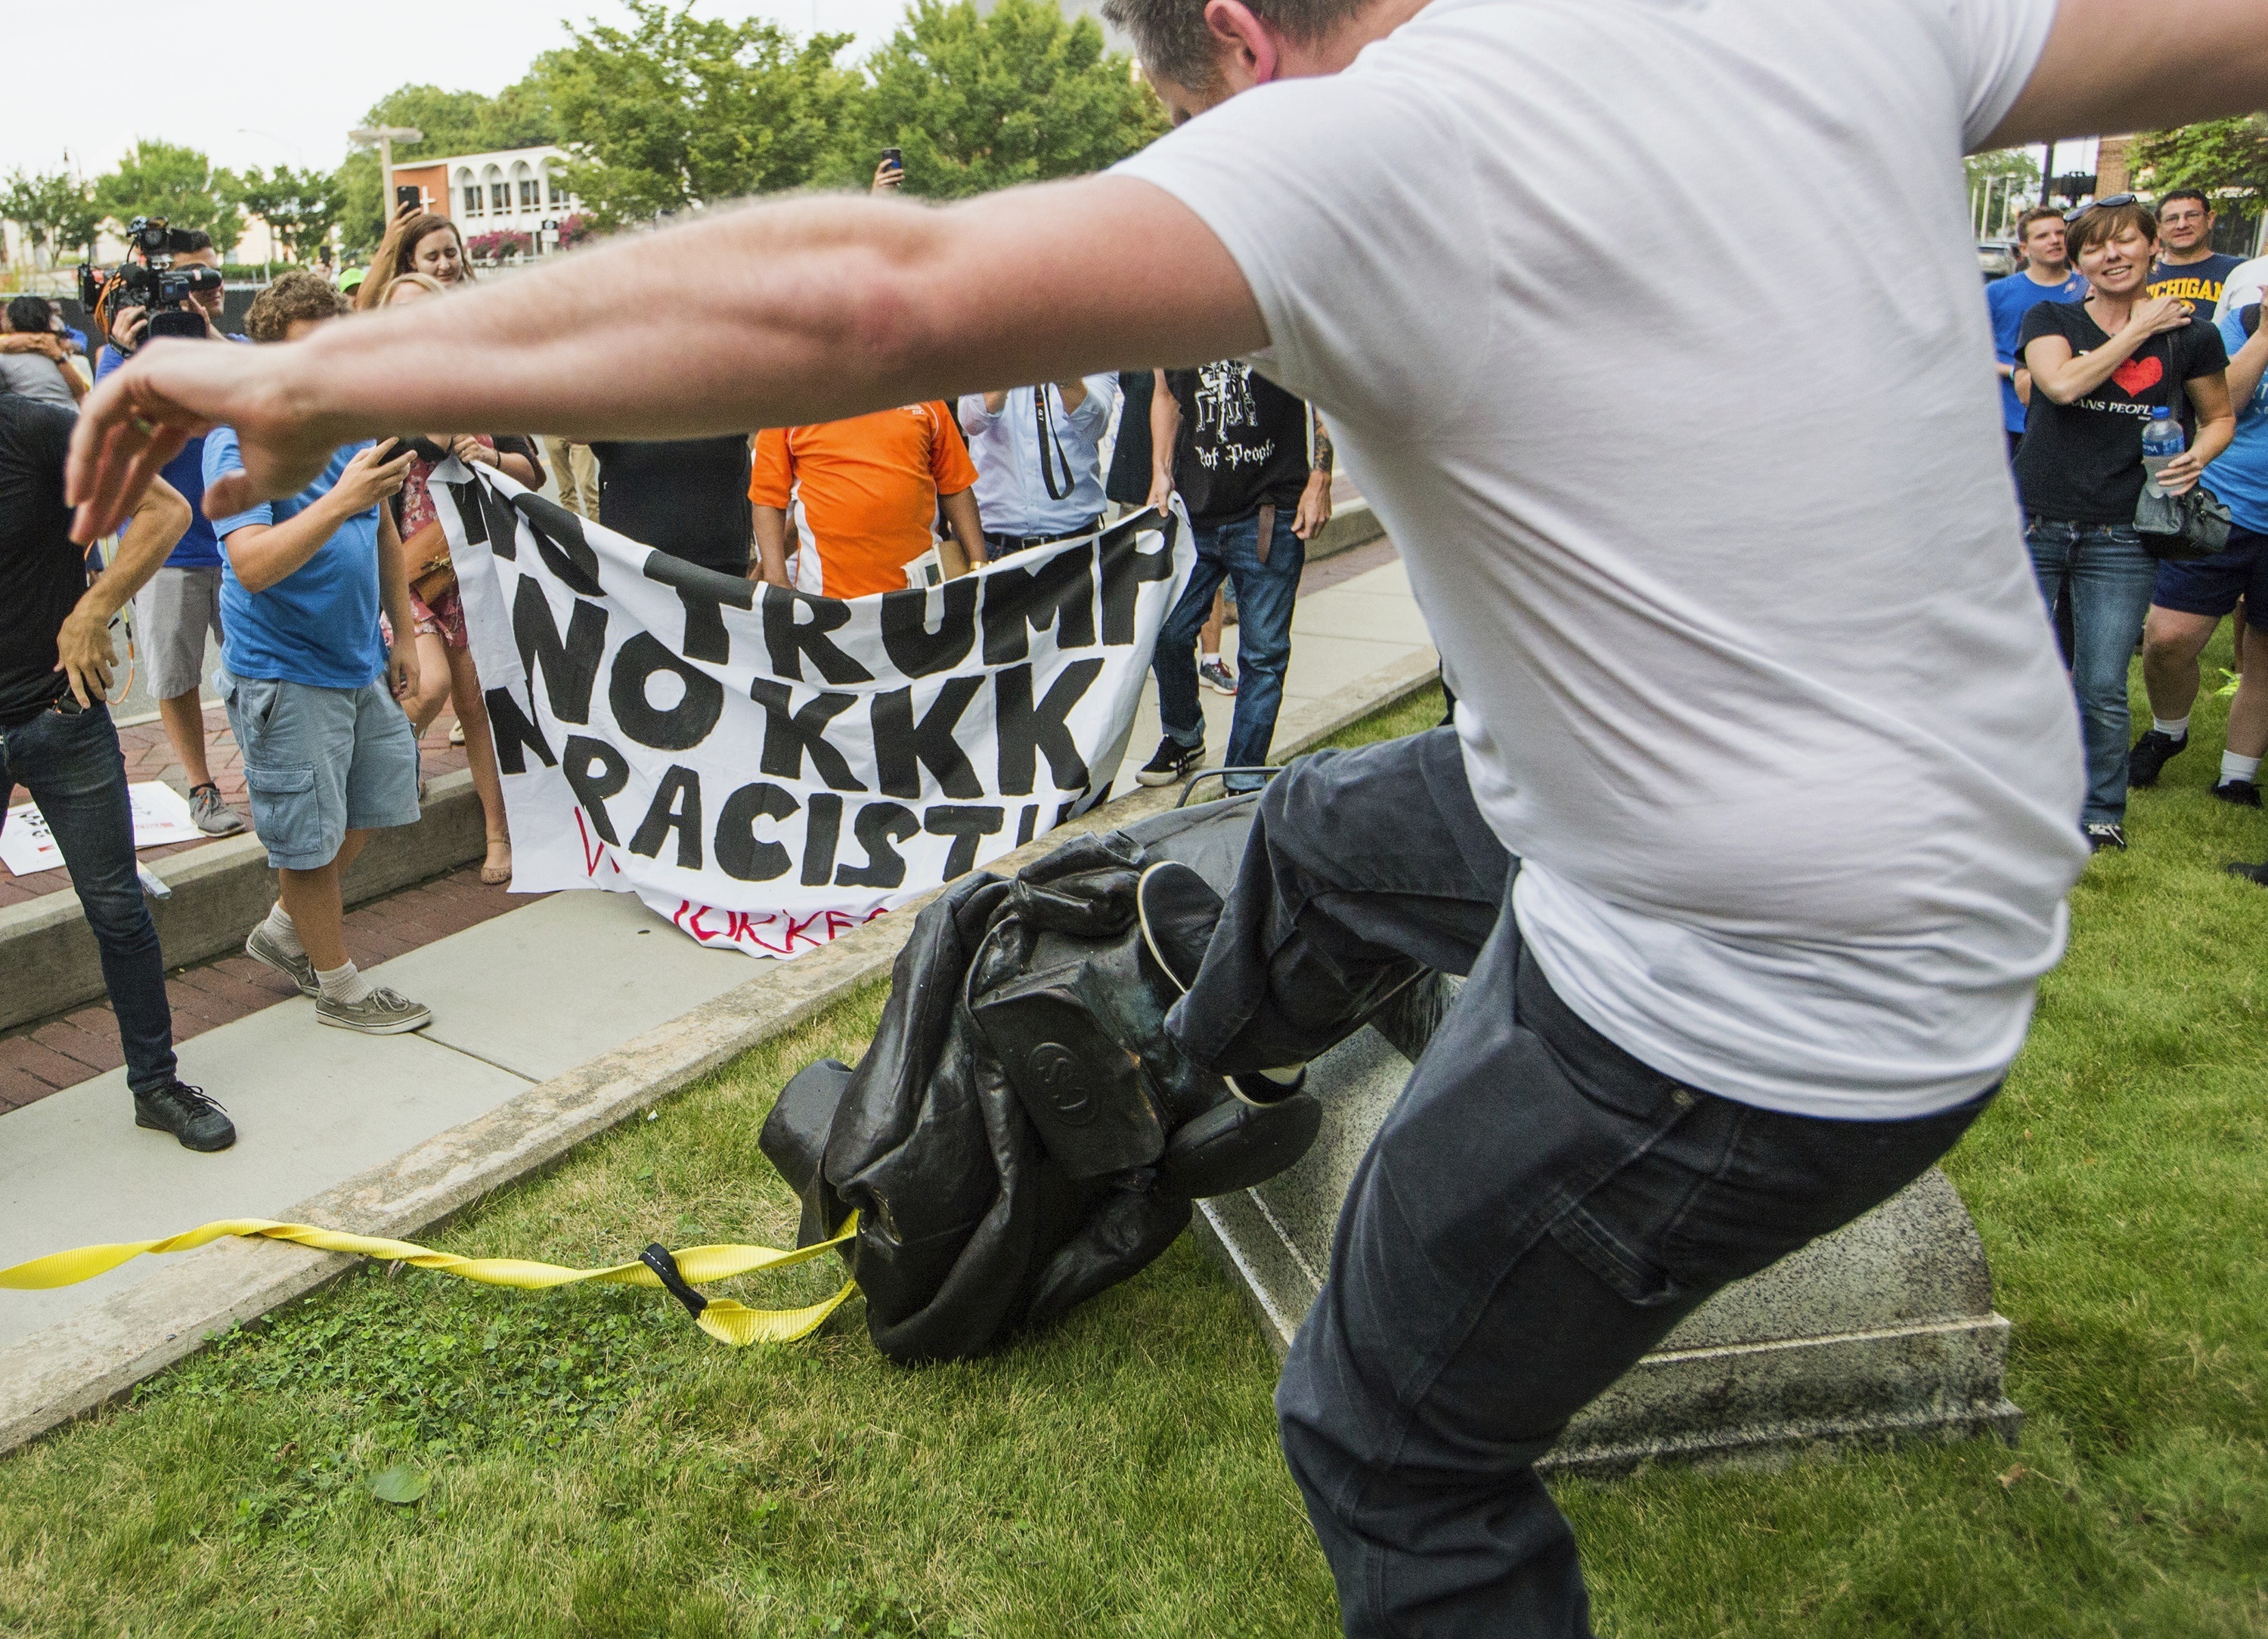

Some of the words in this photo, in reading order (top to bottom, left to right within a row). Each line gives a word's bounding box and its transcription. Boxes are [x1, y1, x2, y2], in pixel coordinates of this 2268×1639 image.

[2146, 277, 2224, 302] ICHIGAN
[2108, 401, 2153, 416] PEOPL
[643, 511, 1176, 685] TRUMP
[512, 573, 725, 751] NO
[750, 657, 1090, 799] KKK
